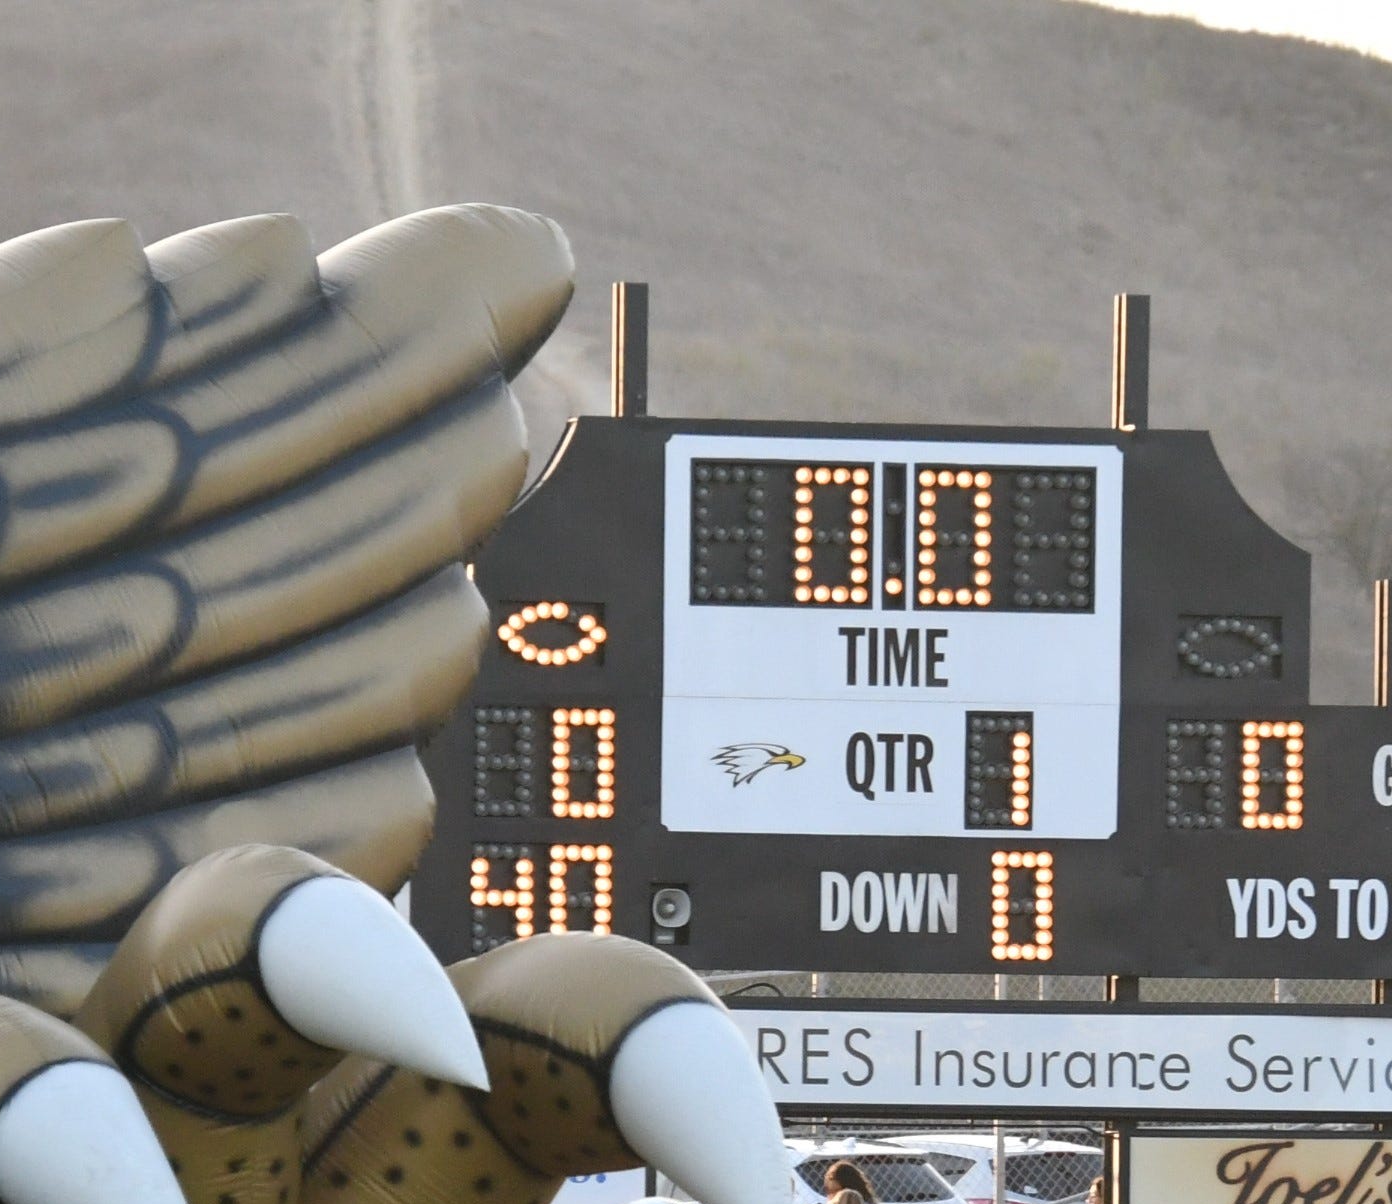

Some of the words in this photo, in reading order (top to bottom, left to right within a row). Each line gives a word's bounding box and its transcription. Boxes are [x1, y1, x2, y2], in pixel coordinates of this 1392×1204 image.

[838, 627, 949, 688] TIME
[552, 708, 615, 819] 0
[845, 732, 934, 801] QTR
[1012, 732, 1032, 827] 1
[1240, 720, 1304, 830] 0
[819, 870, 958, 935] DOWN
[991, 851, 1053, 961] 0
[1226, 876, 1316, 940] YDS
[1329, 878, 1389, 941] TO
[915, 1029, 1191, 1092] Insurance
